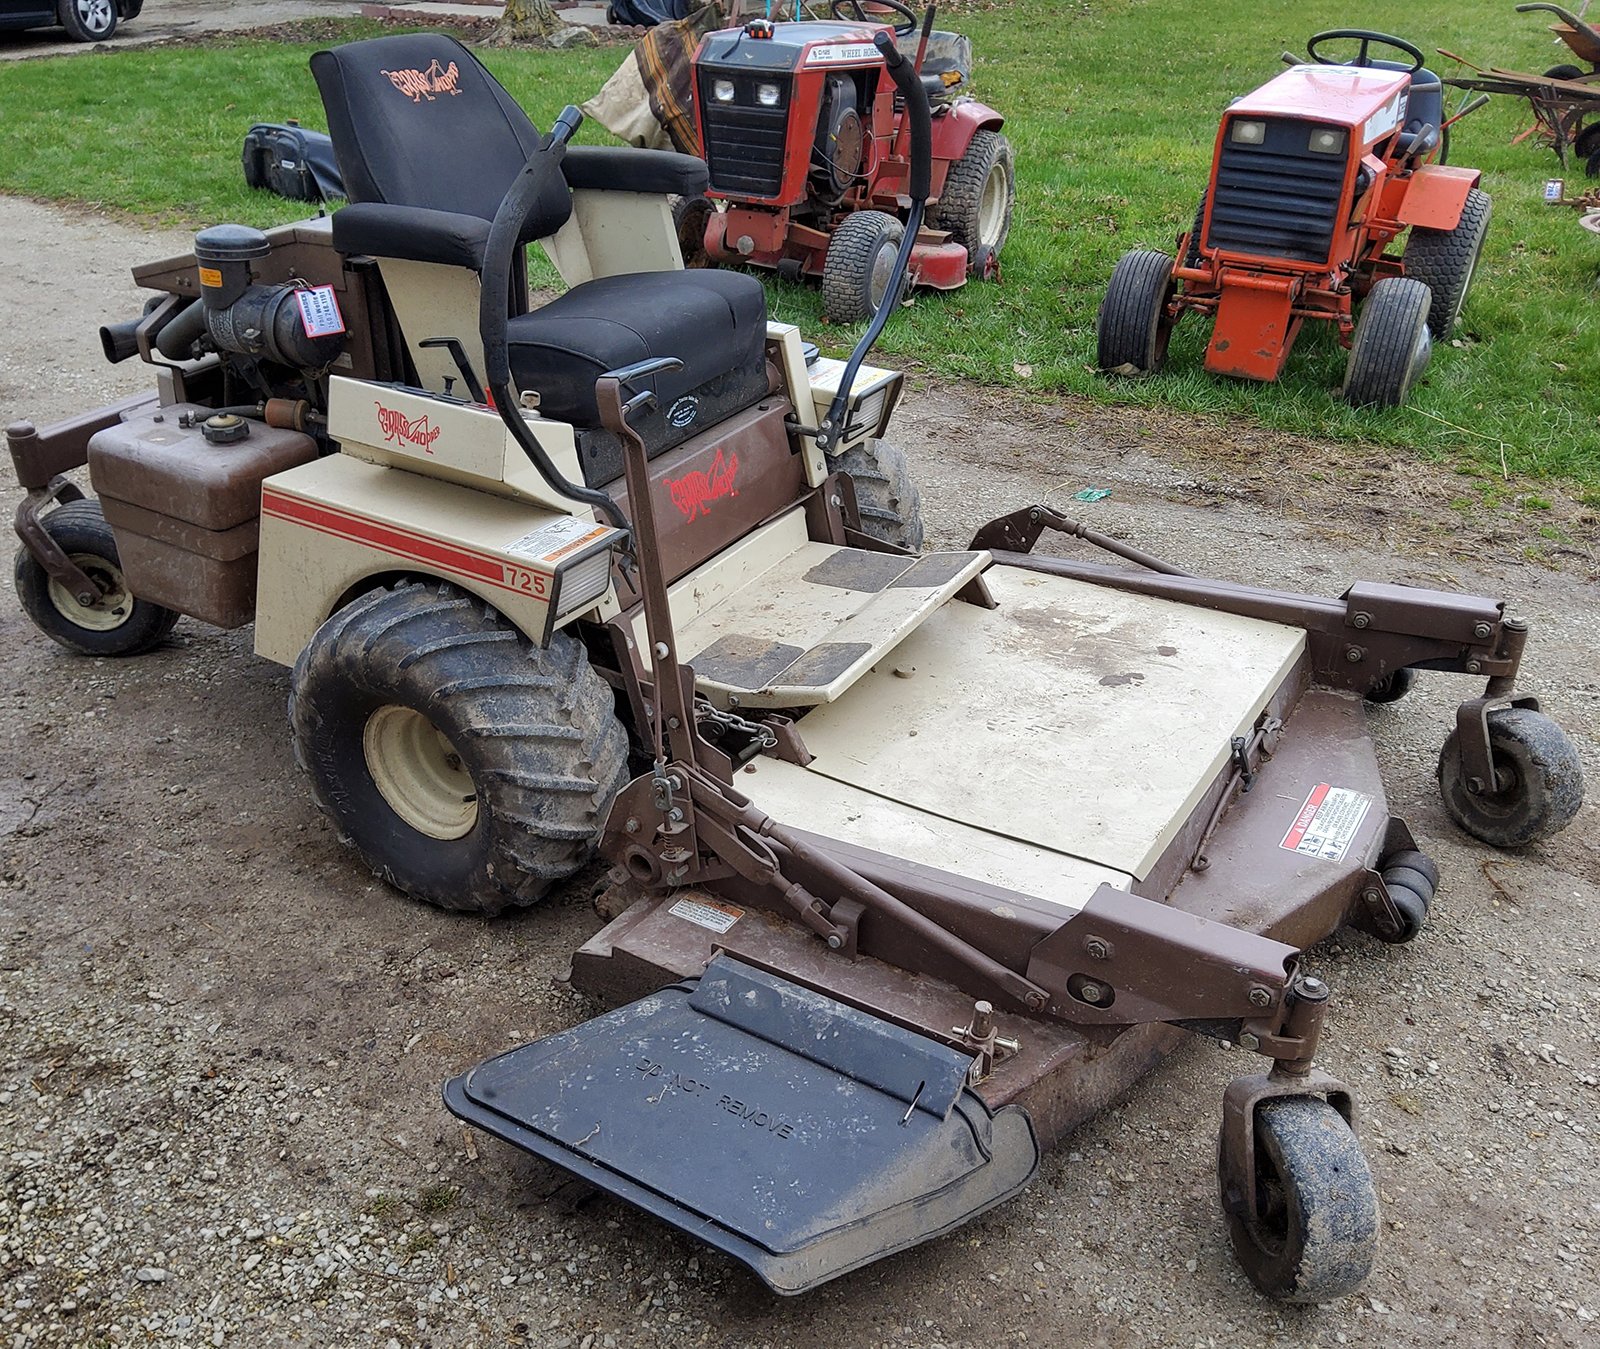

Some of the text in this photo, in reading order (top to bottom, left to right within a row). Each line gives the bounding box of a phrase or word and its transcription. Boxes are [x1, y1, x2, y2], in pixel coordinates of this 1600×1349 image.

[507, 567, 545, 594] 725
[1296, 803, 1319, 827] DANGER
[669, 1074, 711, 1097] NOT
[716, 1094, 794, 1140] REMOVE
